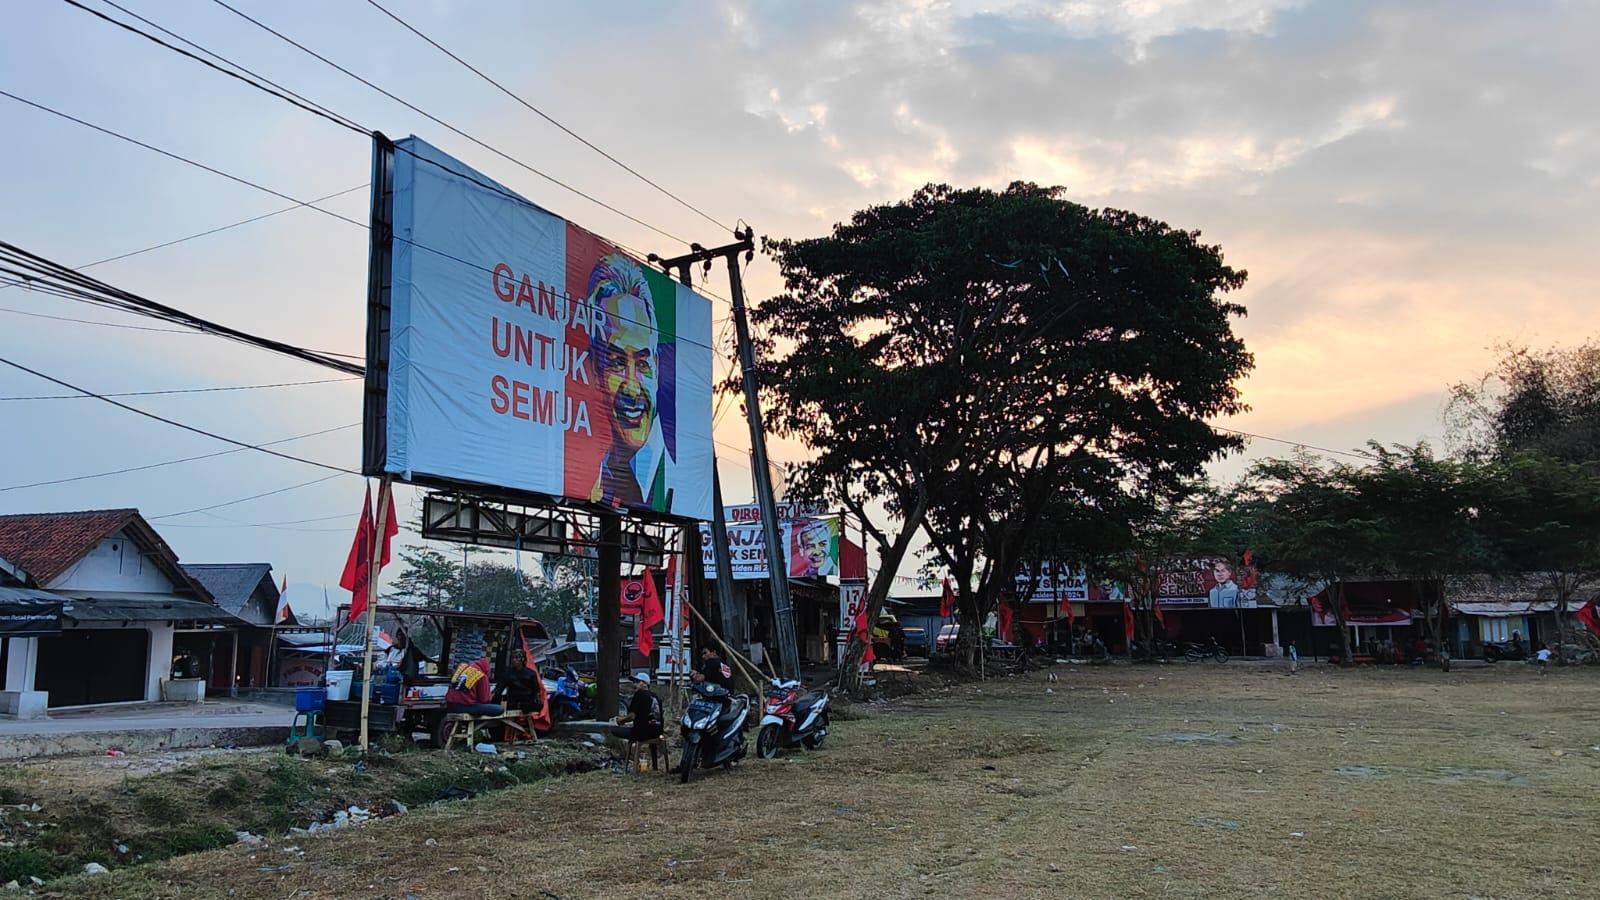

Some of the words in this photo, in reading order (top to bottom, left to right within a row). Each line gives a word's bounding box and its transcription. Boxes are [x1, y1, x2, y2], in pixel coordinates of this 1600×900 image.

[492, 262, 607, 344] GANJAR
[491, 316, 590, 385] UNTUK
[490, 374, 593, 437] SEMUA
[701, 528, 785, 547] GNJA
[1159, 582, 1206, 595] SEMUA
